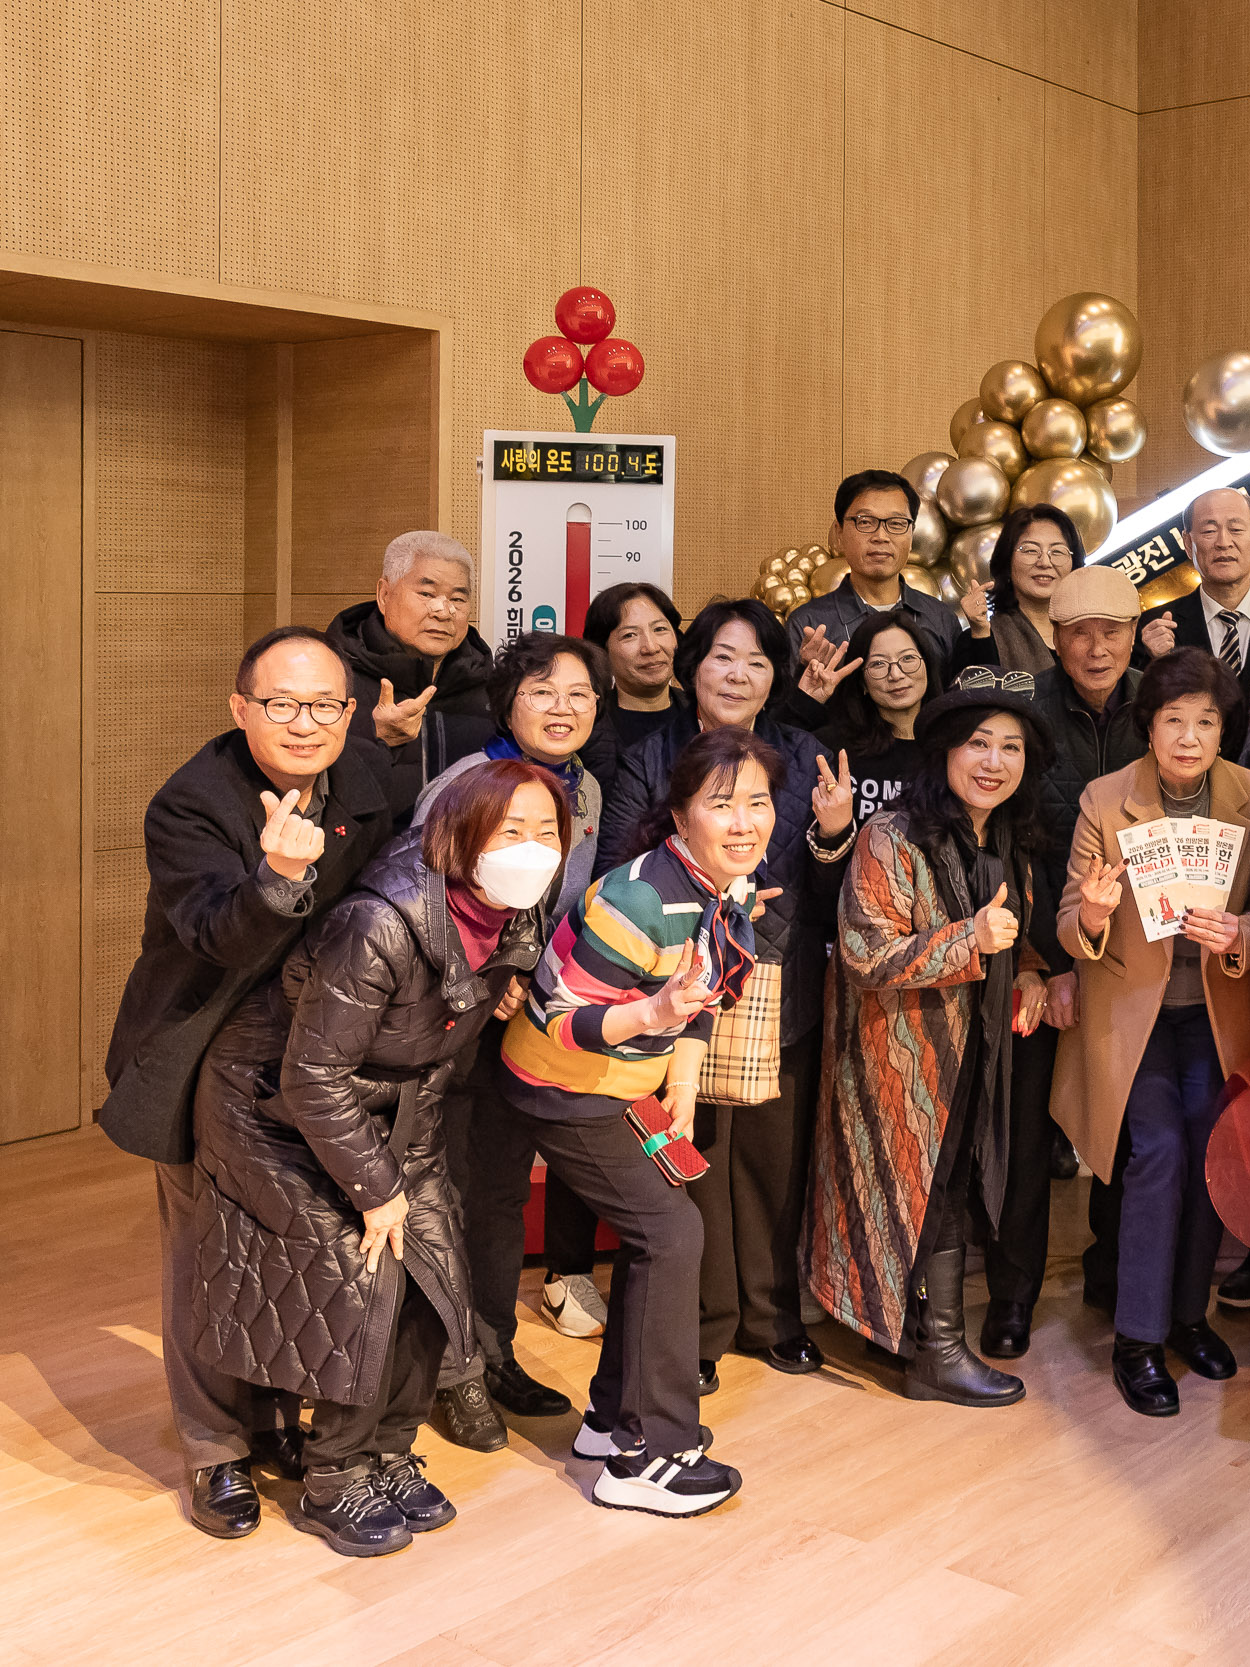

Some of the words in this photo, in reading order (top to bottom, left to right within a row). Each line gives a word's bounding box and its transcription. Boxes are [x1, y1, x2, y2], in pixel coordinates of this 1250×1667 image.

[501, 448, 541, 473] 사랑의
[546, 449, 572, 472] 온도
[626, 520, 647, 531] 100
[508, 531, 523, 602] 2026
[626, 552, 641, 562] 90
[1111, 535, 1175, 585] 광진
[1130, 844, 1171, 866] 따뜻한
[1134, 857, 1174, 875] 겨울나기
